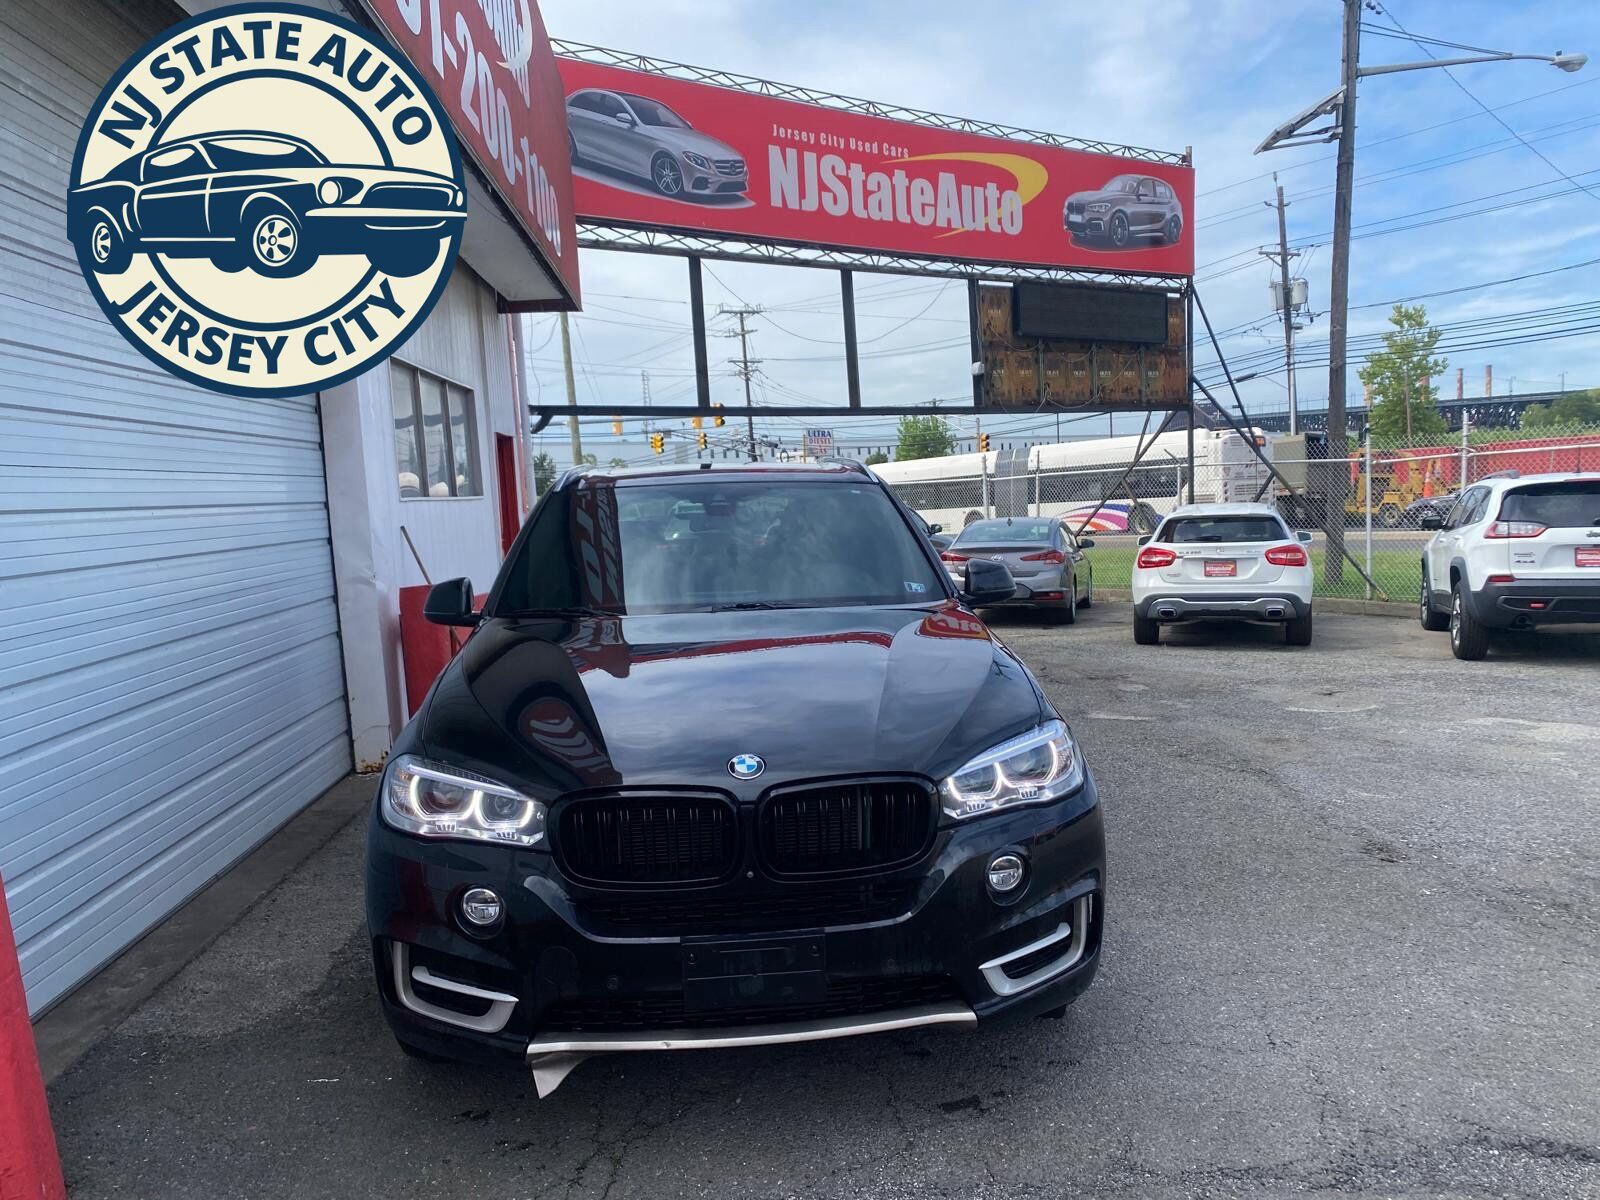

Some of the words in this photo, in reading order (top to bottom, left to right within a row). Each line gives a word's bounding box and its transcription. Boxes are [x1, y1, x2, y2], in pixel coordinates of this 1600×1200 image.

[772, 124, 815, 144] Jersey
[820, 132, 845, 149] City
[849, 137, 879, 154] Used
[883, 142, 910, 158] Cars
[768, 144, 1023, 235] NJStateAuto
[807, 430, 832, 438] ULTRA
